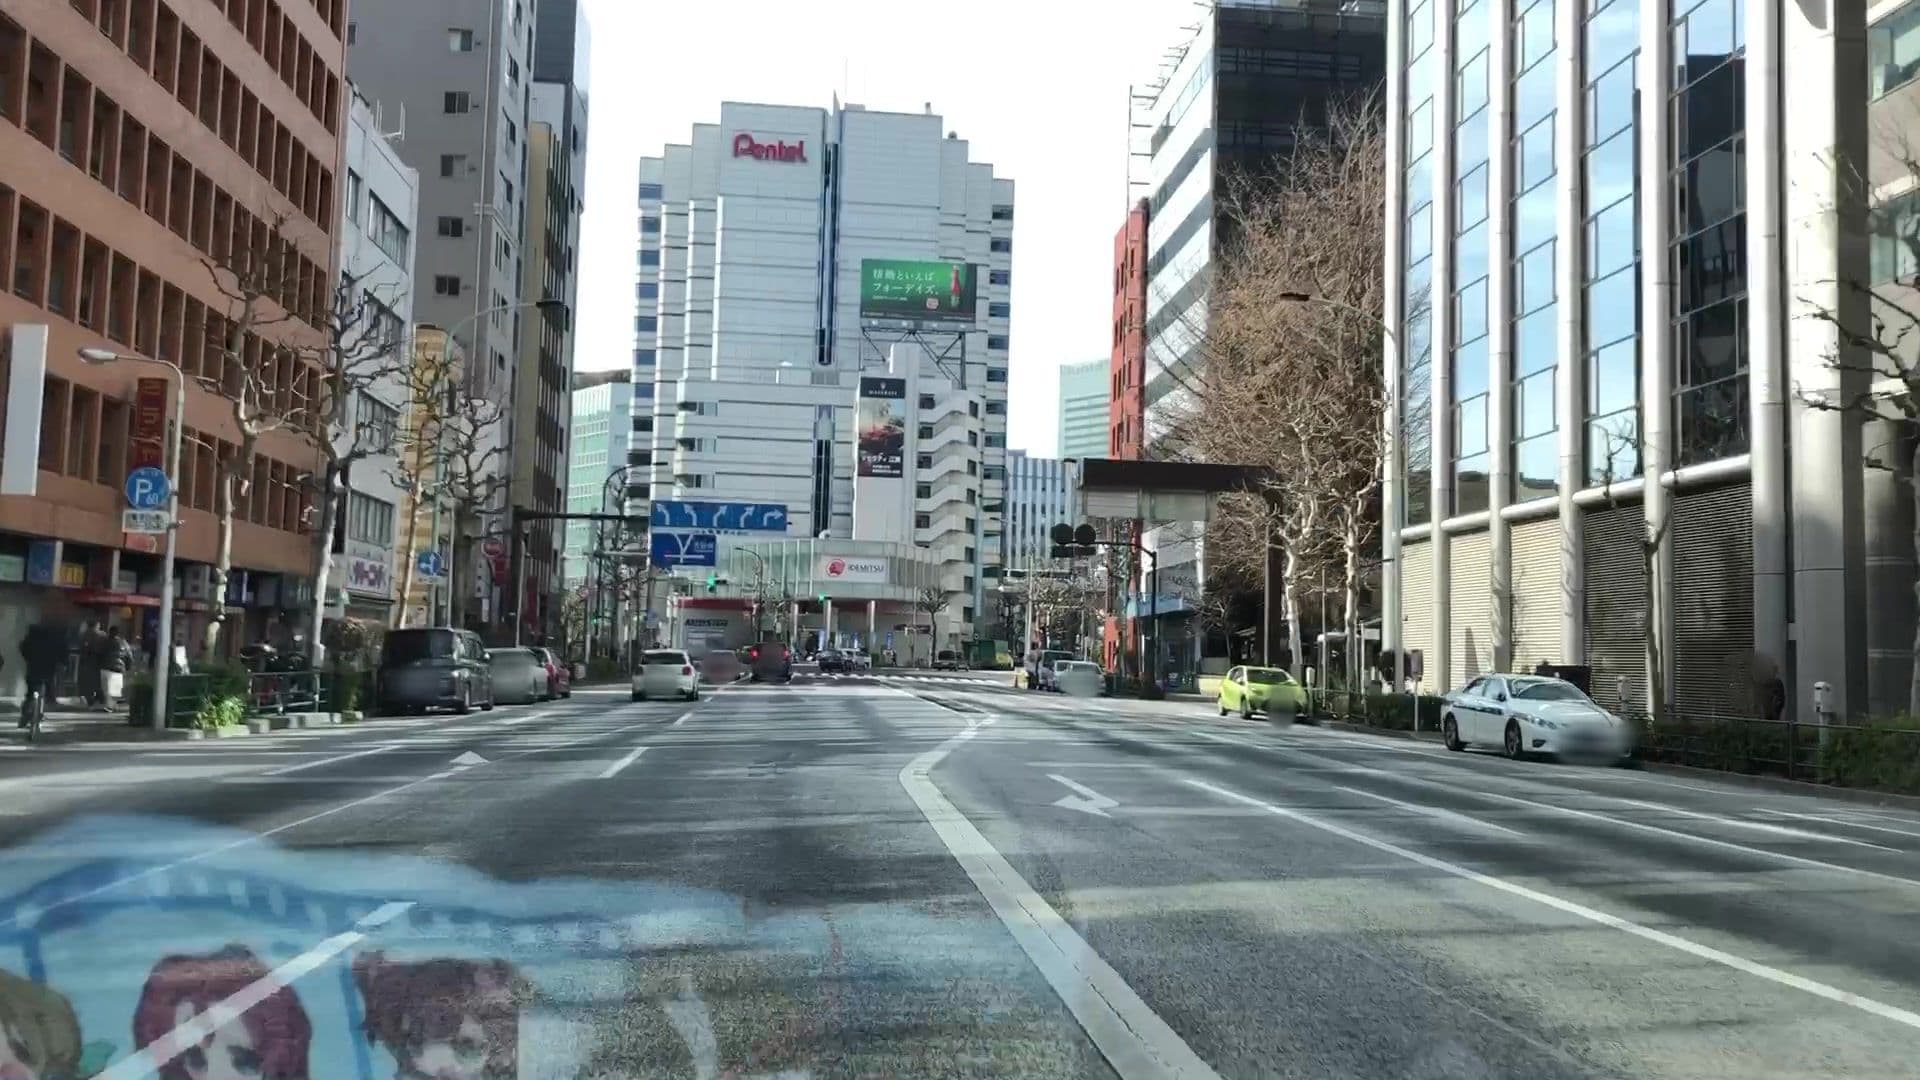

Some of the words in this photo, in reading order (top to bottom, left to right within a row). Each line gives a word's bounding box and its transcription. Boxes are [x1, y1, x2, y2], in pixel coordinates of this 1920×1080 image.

[733, 134, 807, 163] Pentel
[873, 268, 936, 281] といえば
[136, 479, 152, 504] P
[848, 564, 884, 573] IDEMITSU
